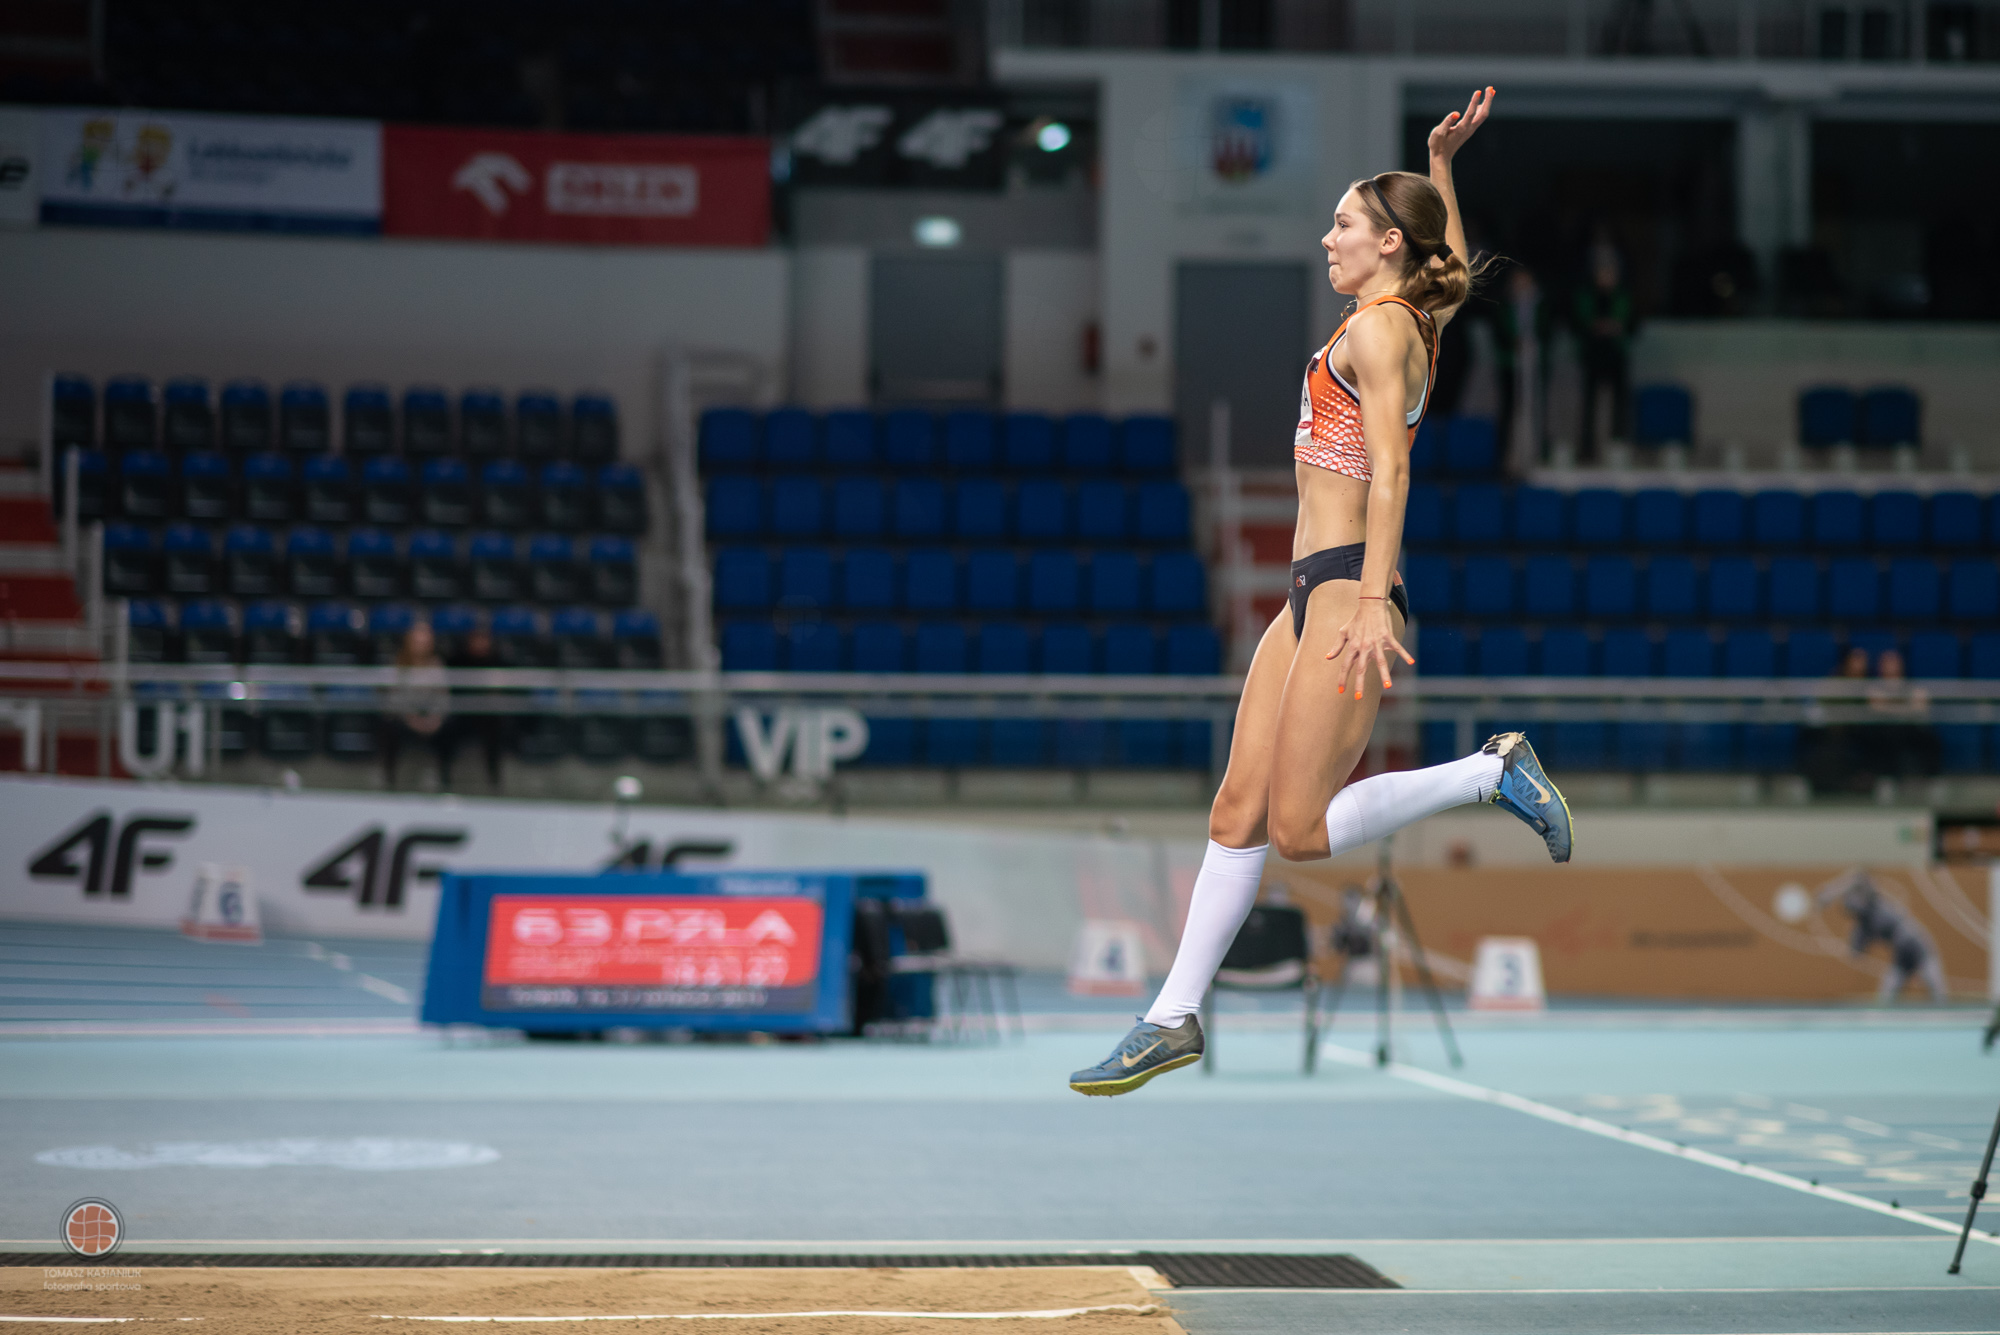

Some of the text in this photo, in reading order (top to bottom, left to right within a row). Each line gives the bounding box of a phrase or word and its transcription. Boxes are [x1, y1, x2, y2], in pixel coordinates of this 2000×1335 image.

[736, 709, 869, 780] VIP
[28, 813, 195, 897] 4F
[302, 827, 467, 910] 4F
[218, 881, 243, 926] 6
